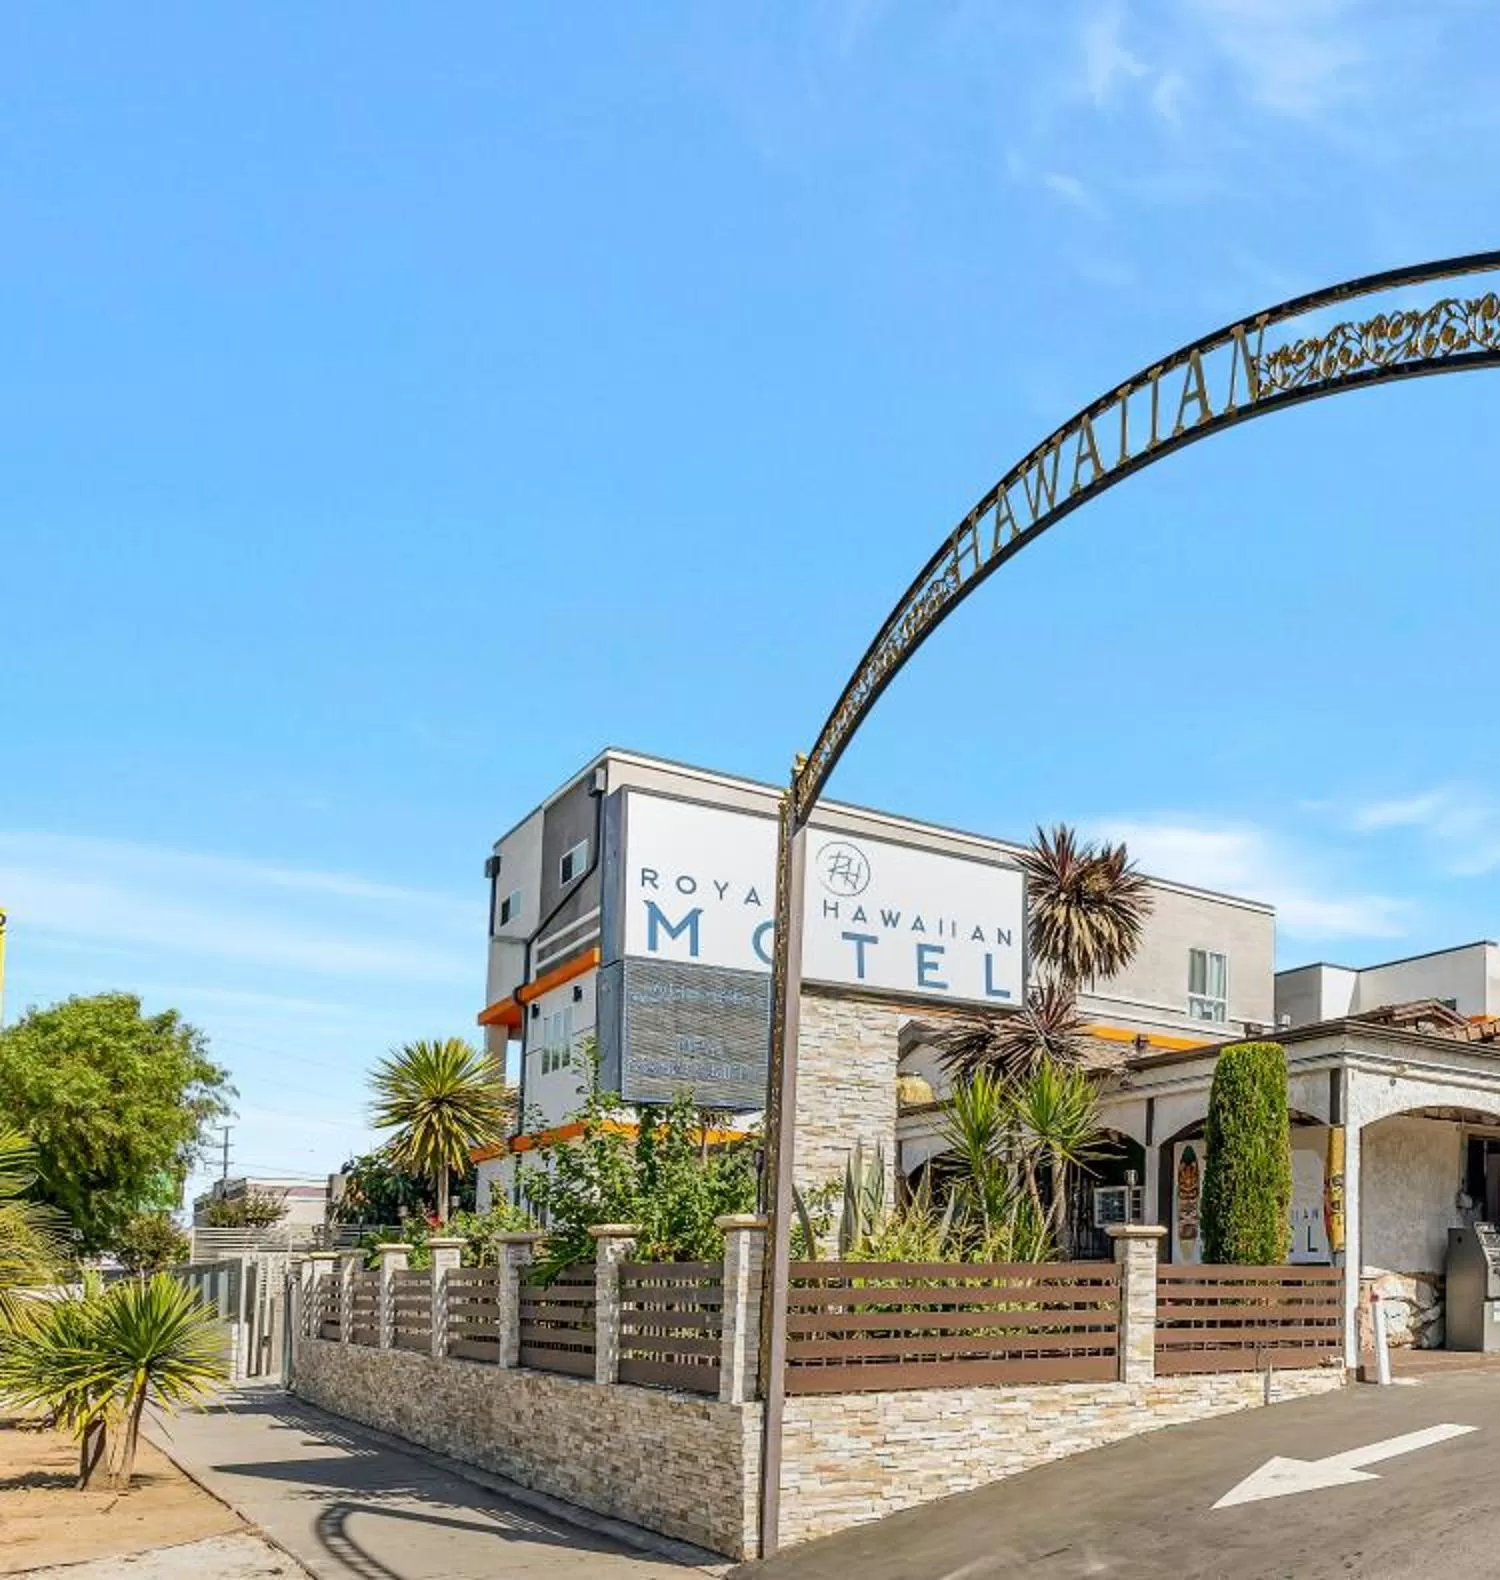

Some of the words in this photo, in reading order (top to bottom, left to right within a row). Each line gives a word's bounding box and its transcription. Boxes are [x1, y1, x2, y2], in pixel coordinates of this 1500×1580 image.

[950, 313, 1271, 588] HAWAIIAN
[641, 867, 762, 907] ROYA
[823, 899, 1013, 946] HAWAIIAN
